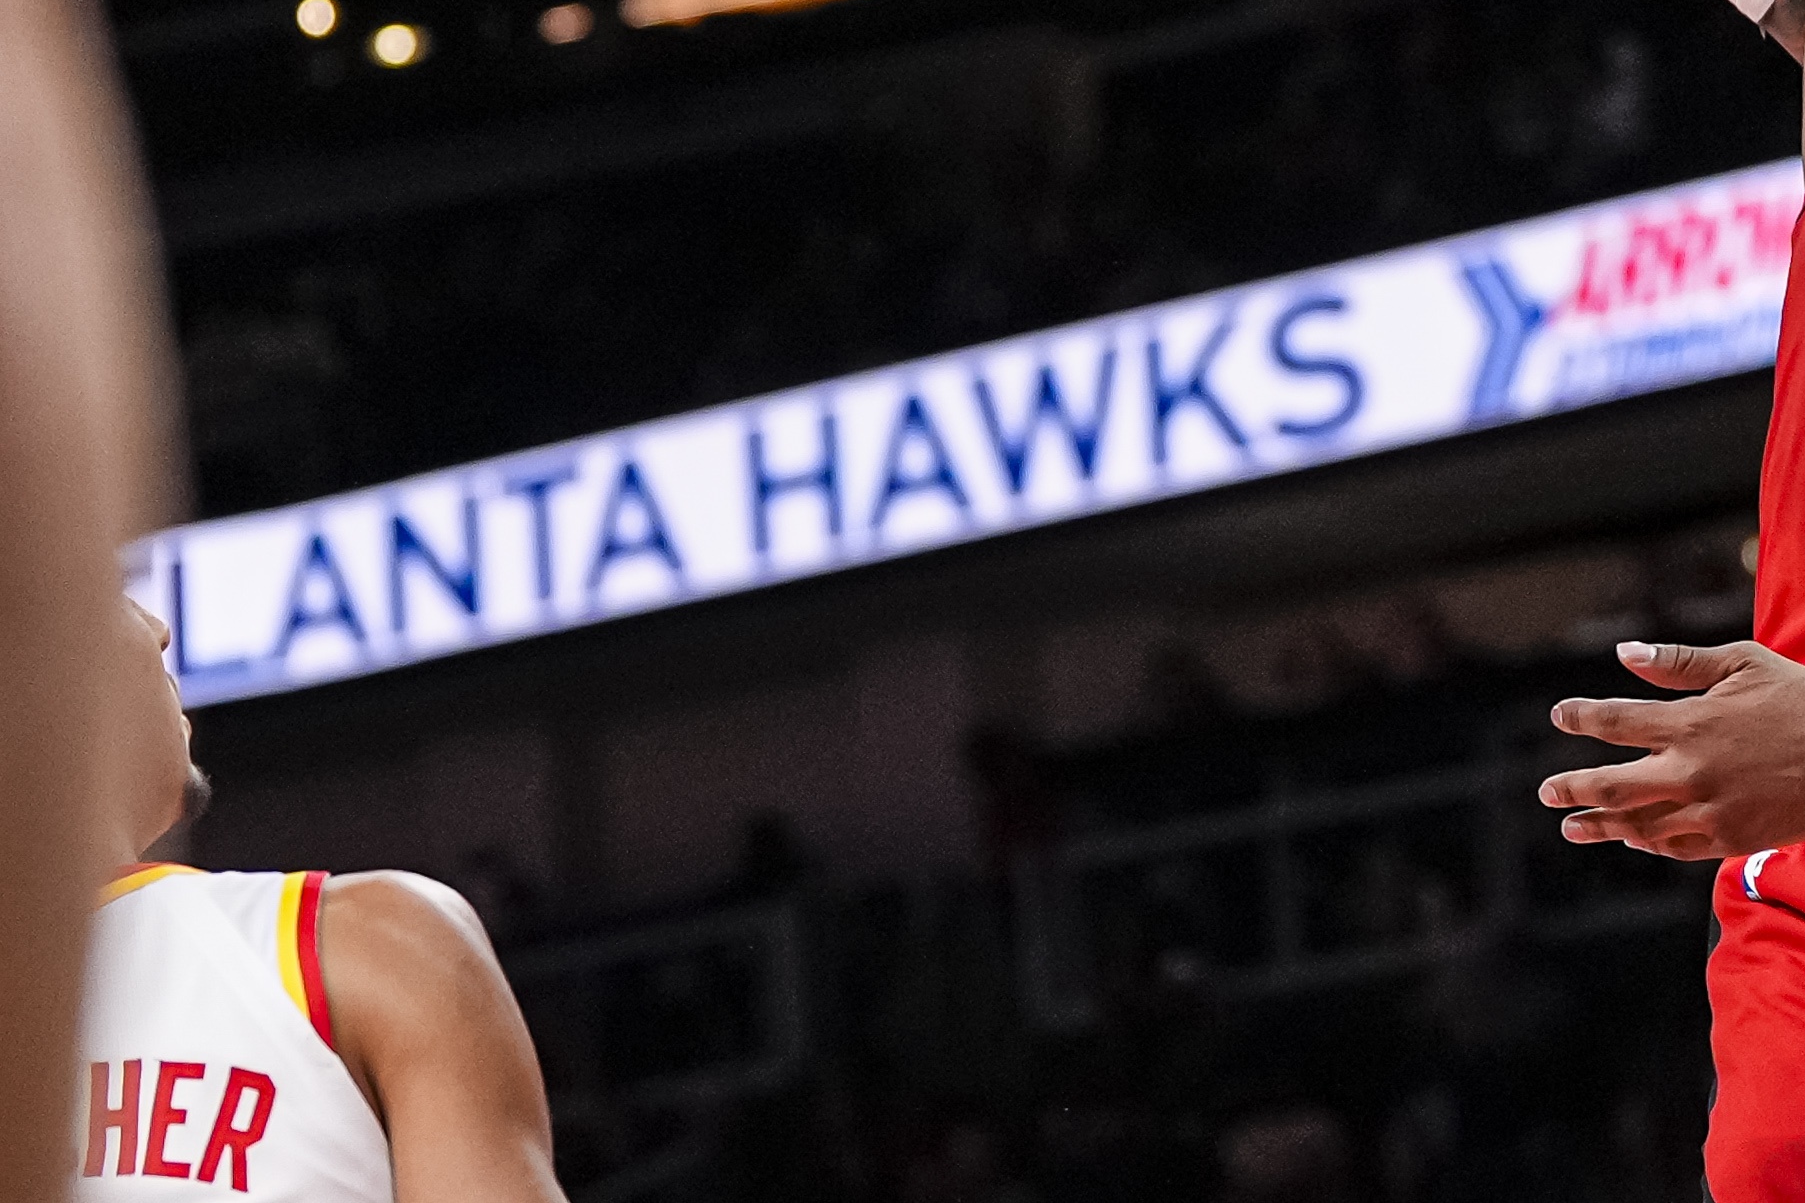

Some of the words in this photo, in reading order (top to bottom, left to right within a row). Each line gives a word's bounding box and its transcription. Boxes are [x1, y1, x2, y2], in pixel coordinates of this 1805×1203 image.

[122, 451, 688, 680] LANTA
[744, 292, 1366, 558] HAWKS
[83, 1058, 277, 1193] HER
